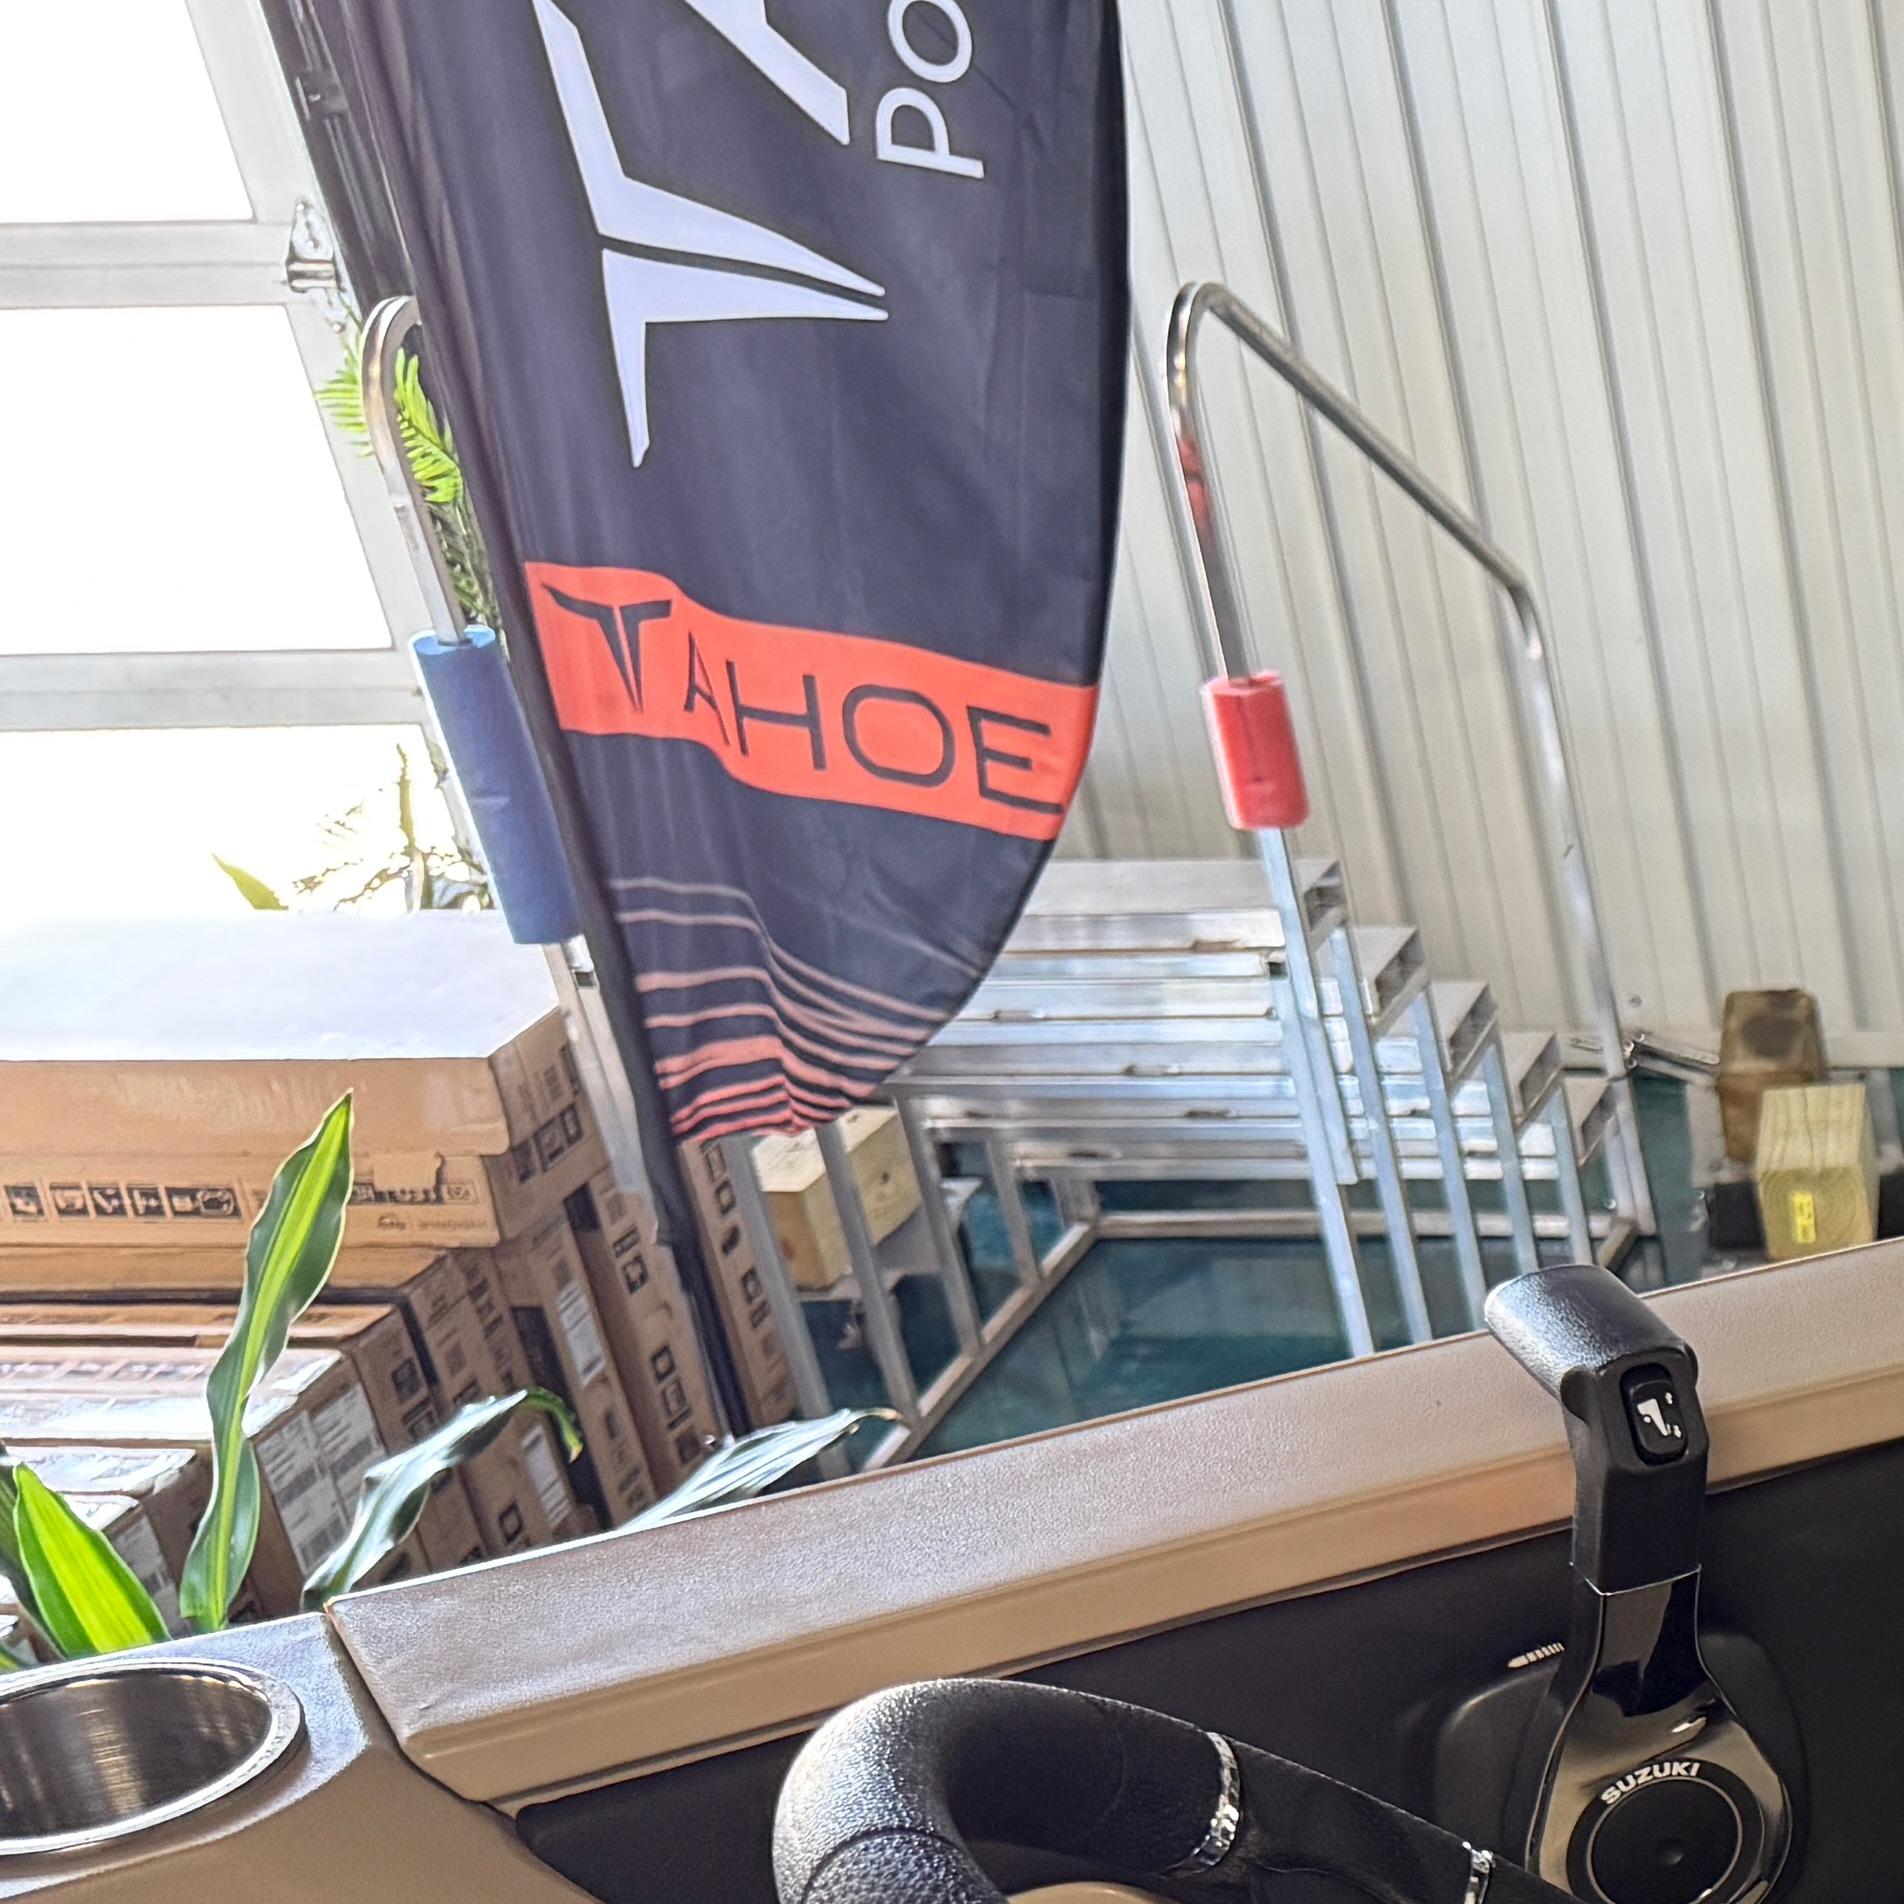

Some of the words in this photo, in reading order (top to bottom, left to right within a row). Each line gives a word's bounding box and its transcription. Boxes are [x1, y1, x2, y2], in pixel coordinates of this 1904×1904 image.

[876, 0, 984, 179] PO
[541, 582, 1065, 816] TAHOE
[1601, 1762, 1700, 1805] SUZUKI
